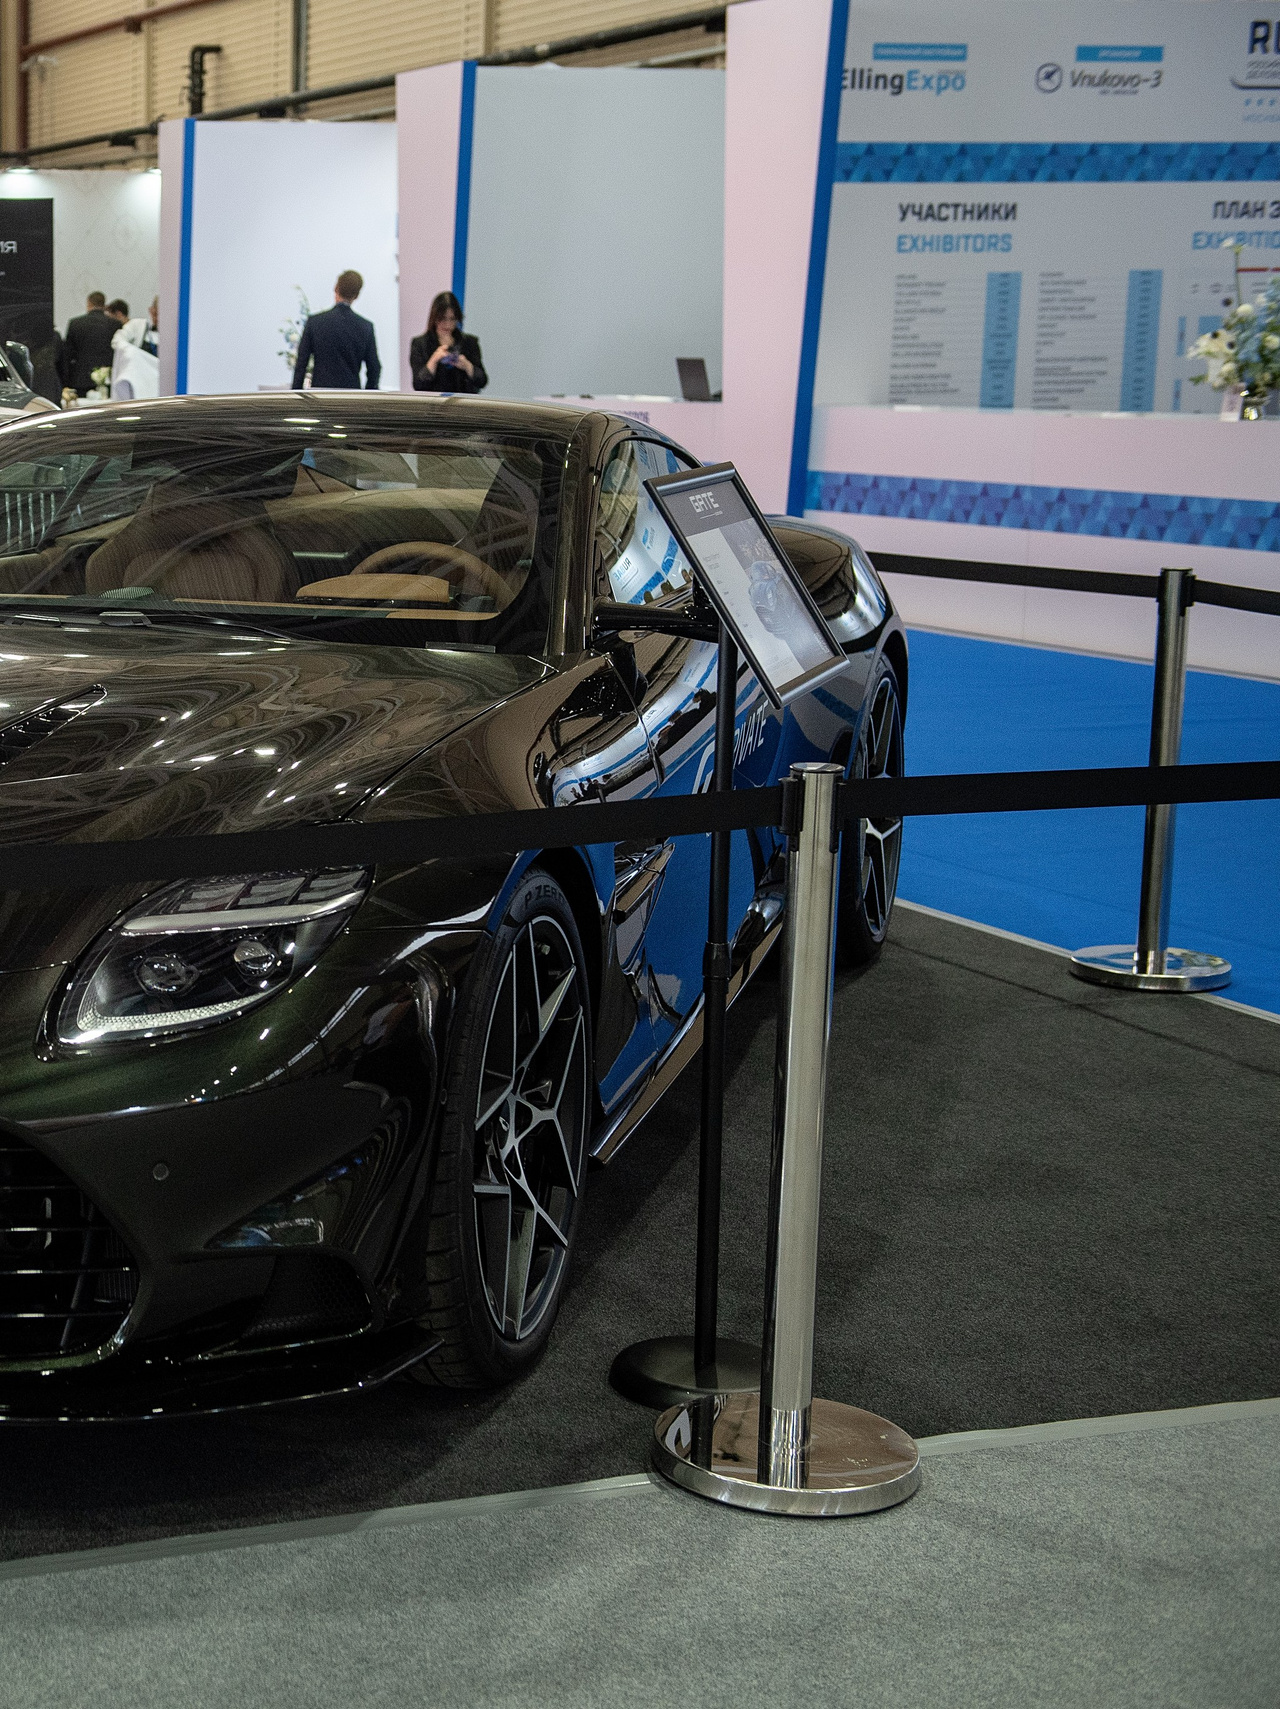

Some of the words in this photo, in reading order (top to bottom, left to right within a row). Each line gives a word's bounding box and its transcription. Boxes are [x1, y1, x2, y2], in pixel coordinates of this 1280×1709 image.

[1070, 69, 1164, 89] Vnukovo-3
[898, 202, 1017, 222] УЧАСТНИКИ
[1213, 200, 1266, 219] ПЛАН
[896, 233, 1013, 253] EXHIBITORS
[688, 491, 720, 513] GATE
